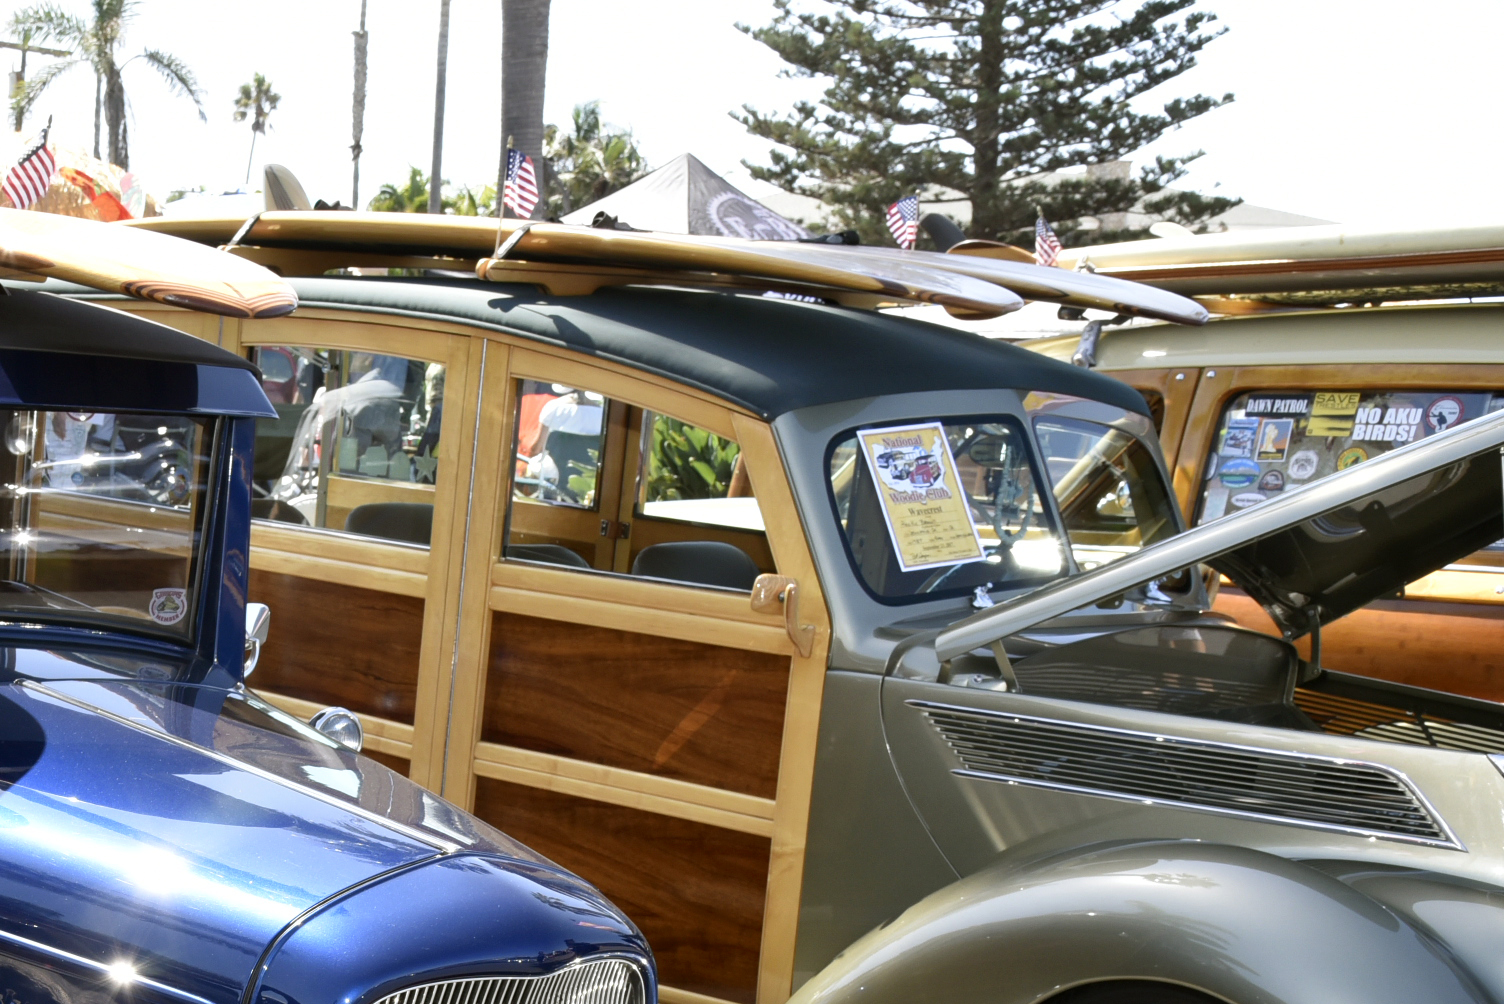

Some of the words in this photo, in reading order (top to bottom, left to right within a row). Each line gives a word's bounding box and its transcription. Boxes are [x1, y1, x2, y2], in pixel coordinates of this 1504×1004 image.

[1316, 393, 1359, 404] SAVE
[1246, 399, 1274, 412] DAWN
[1273, 399, 1308, 413] PATROL
[1355, 408, 1382, 424] NO
[1383, 408, 1423, 424] AKU
[1352, 424, 1417, 441] BIRDS!
[882, 435, 923, 448] National
[889, 490, 924, 504] Woodie
[926, 487, 950, 500] Club
[908, 506, 942, 516] Wavecrest
